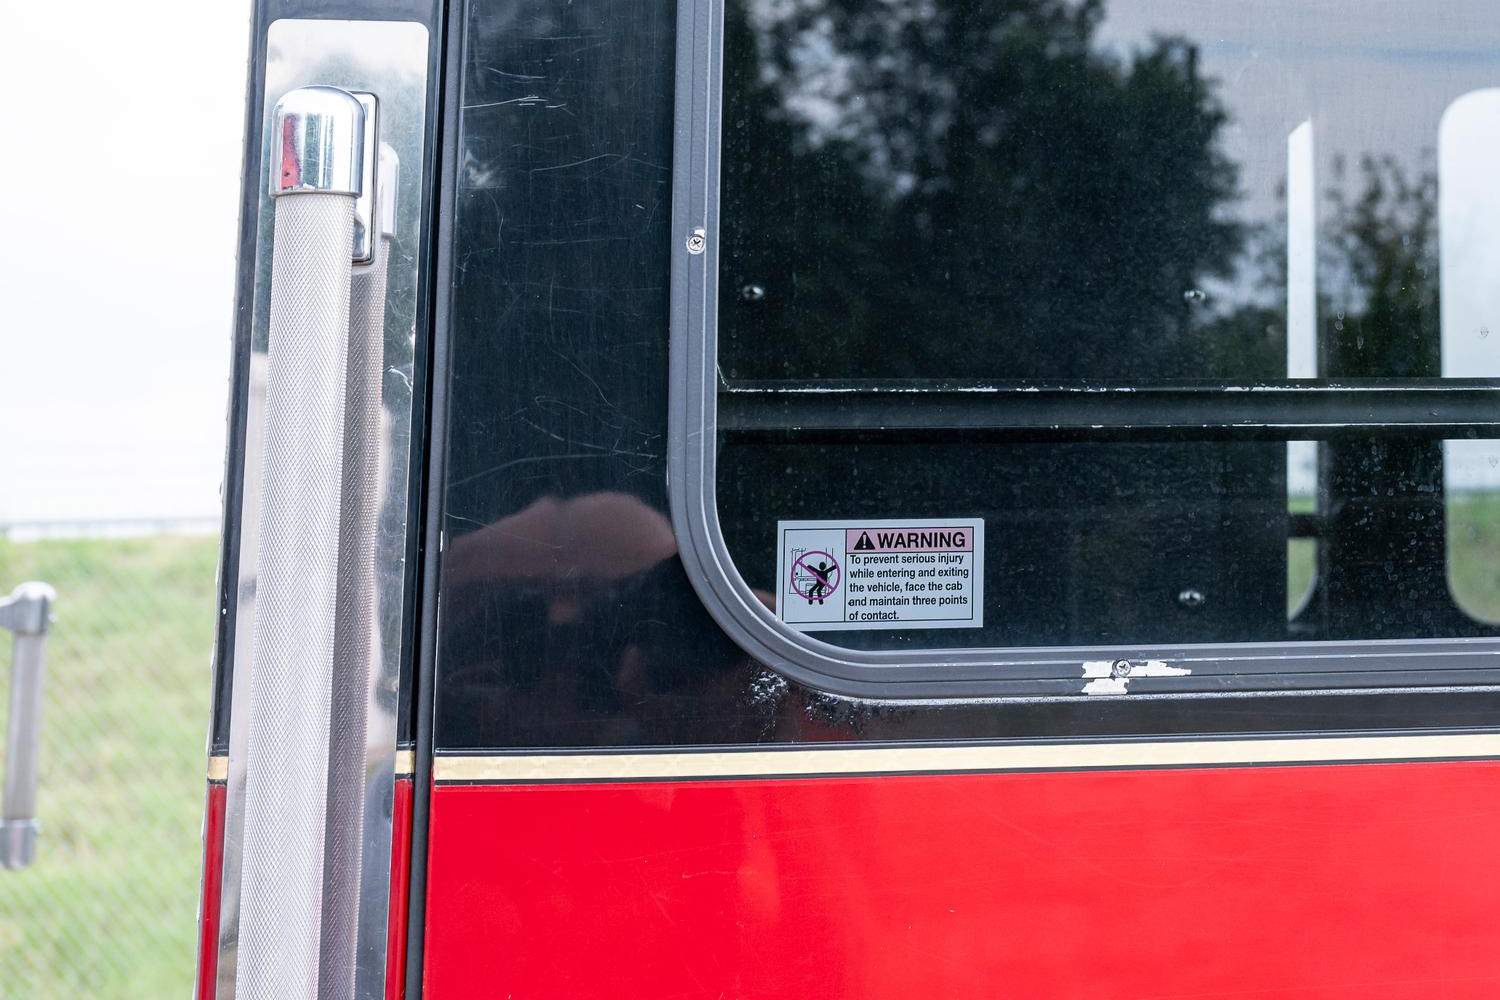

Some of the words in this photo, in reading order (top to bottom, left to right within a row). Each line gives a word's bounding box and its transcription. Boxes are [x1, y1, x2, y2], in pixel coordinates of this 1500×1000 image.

[877, 532, 965, 548] WARNING
[850, 555, 861, 564] To
[864, 555, 899, 566] prevent
[902, 554, 935, 563] serious
[938, 553, 964, 564] injury
[850, 569, 874, 578] while
[877, 569, 915, 580] entering
[918, 568, 935, 577] and
[938, 568, 968, 578] exiting
[850, 583, 864, 592] the
[867, 582, 903, 593] vehicle,
[905, 582, 926, 591] face
[928, 582, 942, 590] the
[945, 581, 962, 590] cab
[849, 596, 867, 606] and
[870, 596, 910, 606] maintain
[912, 596, 936, 605] three
[939, 595, 967, 606] points
[849, 611, 859, 620] of
[861, 610, 899, 620] contact.
